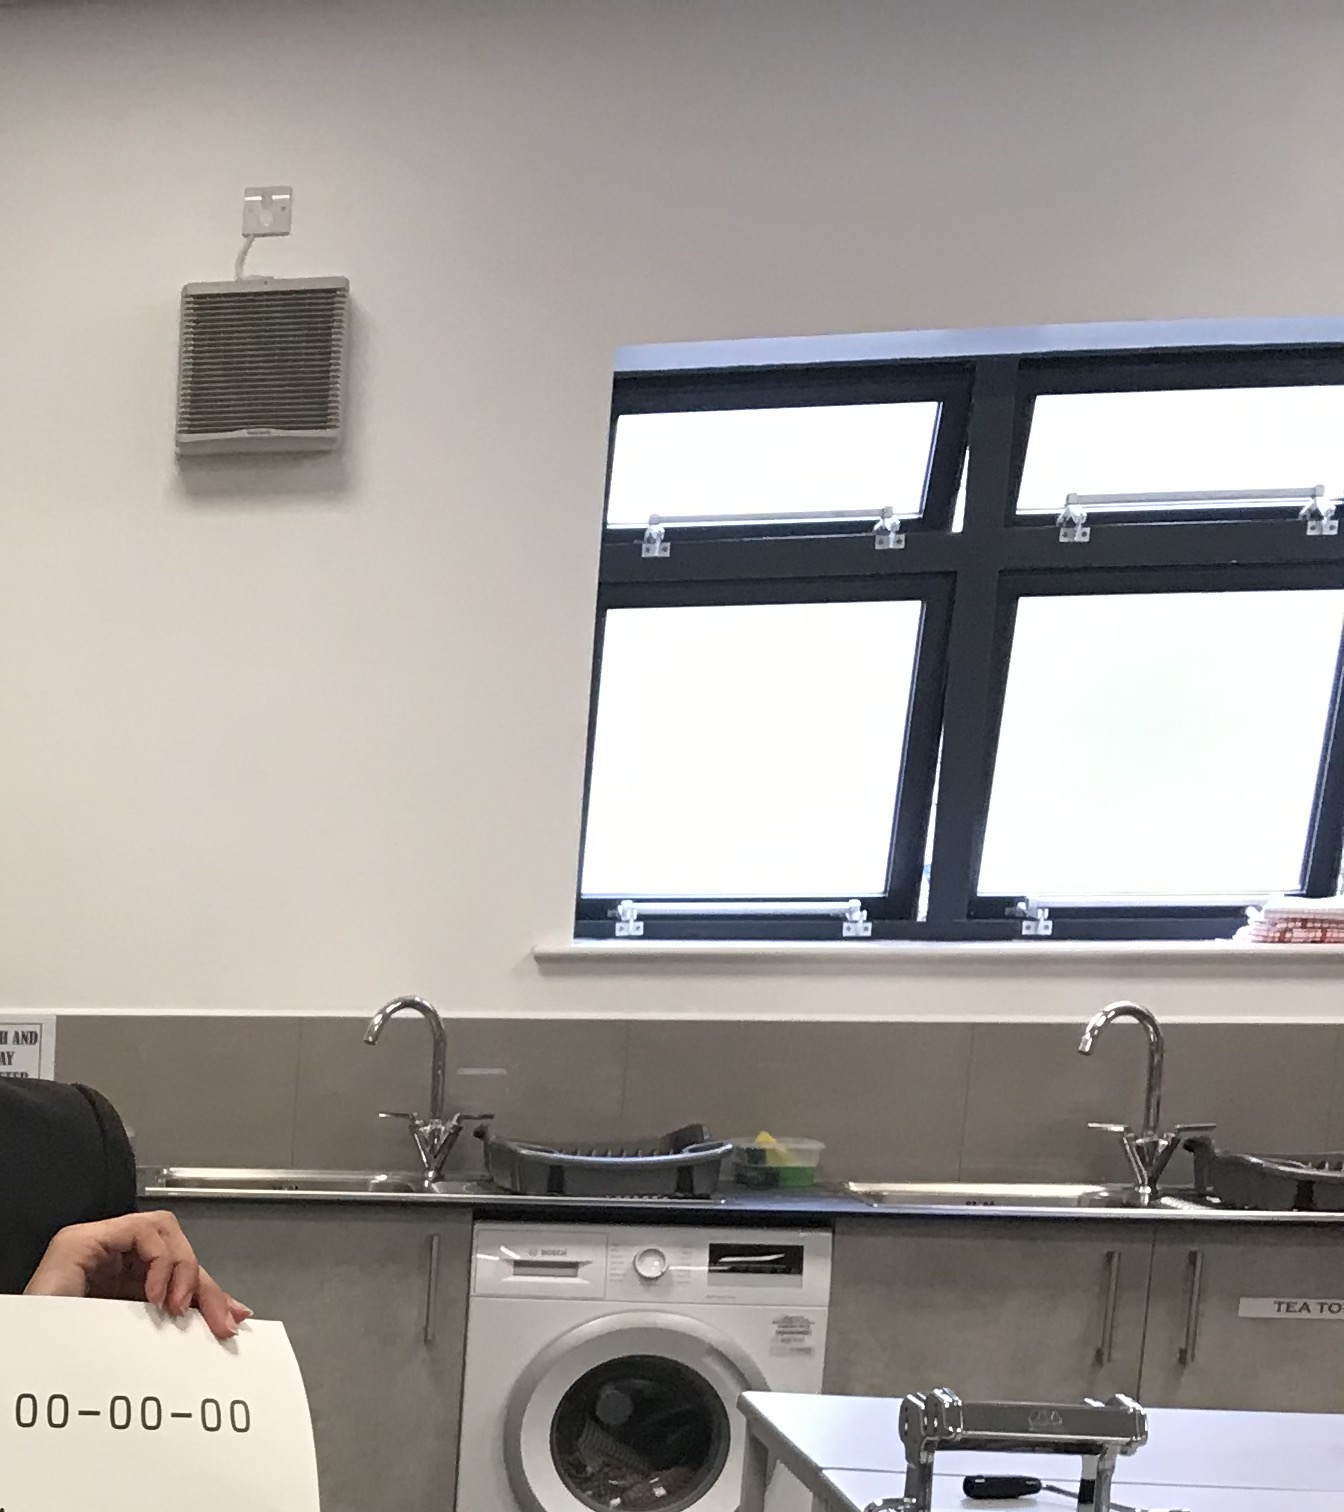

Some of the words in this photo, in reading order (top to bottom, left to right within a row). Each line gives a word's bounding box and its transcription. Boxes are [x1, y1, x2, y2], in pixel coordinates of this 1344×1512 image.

[12, 1030, 39, 1045] AND
[1273, 1301, 1311, 1314] TEA
[1316, 1302, 1344, 1315] TO
[15, 1393, 252, 1434] 00-00-00
